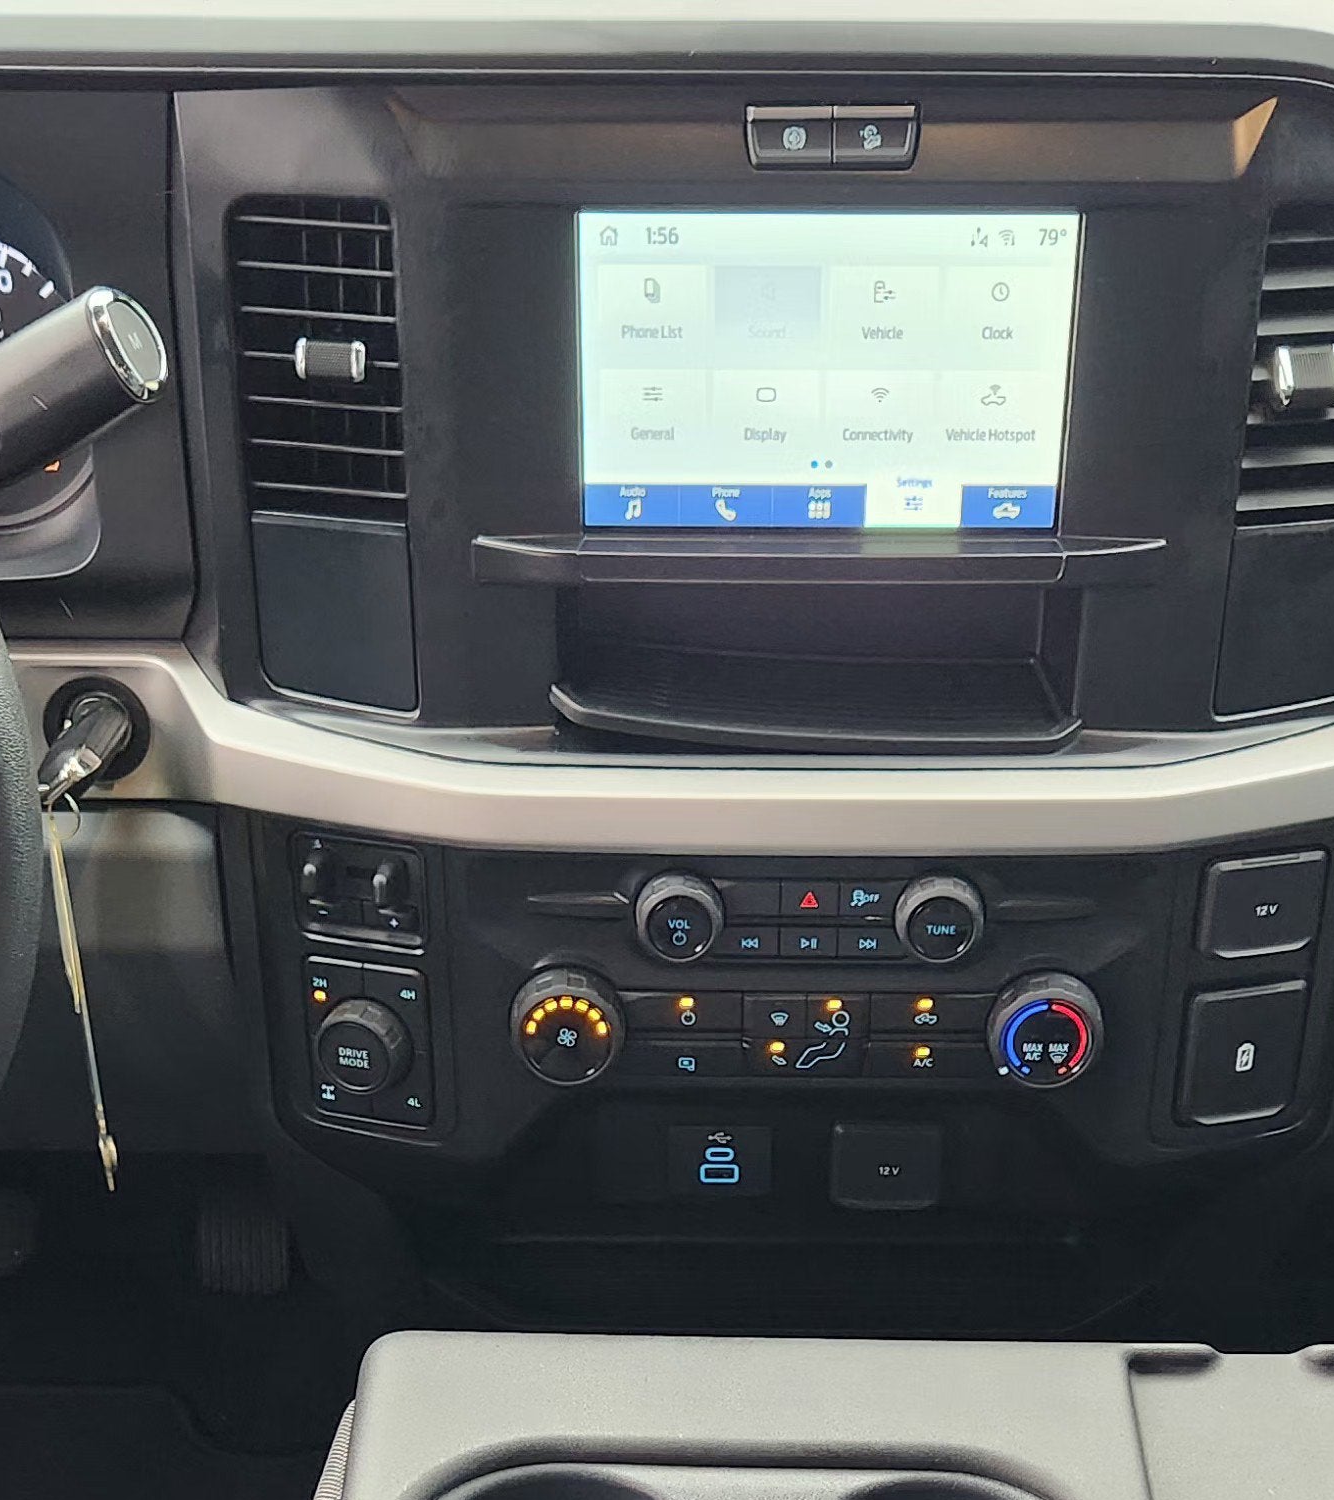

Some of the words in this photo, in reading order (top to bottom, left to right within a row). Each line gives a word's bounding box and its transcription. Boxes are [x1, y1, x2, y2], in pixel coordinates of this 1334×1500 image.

[645, 226, 680, 245] 1:56
[1038, 228, 1068, 246] 79°
[621, 324, 659, 339] Phone
[661, 324, 684, 339] List
[862, 325, 904, 340] Vehicle
[981, 325, 1014, 340] Clock
[630, 426, 675, 441] General
[744, 426, 787, 443] Display
[842, 427, 914, 444] Connectivity
[945, 427, 986, 442] Vehicle
[988, 427, 1036, 444] Hotspot
[897, 476, 932, 489] Settings
[619, 486, 646, 498] Audio
[711, 486, 741, 499] Phone
[808, 486, 832, 500] Apps
[987, 486, 1028, 499] Features
[667, 919, 691, 931] VOL
[926, 924, 957, 937] TUNE
[312, 976, 328, 988] 2H
[399, 989, 416, 1000] 4H
[338, 1046, 369, 1060] DRIVE
[1022, 1042, 1044, 1053] MAX
[1048, 1042, 1070, 1053] MAX
[338, 1057, 370, 1069] MODE
[913, 1057, 934, 1069] A/C
[407, 1097, 422, 1108] 4L
